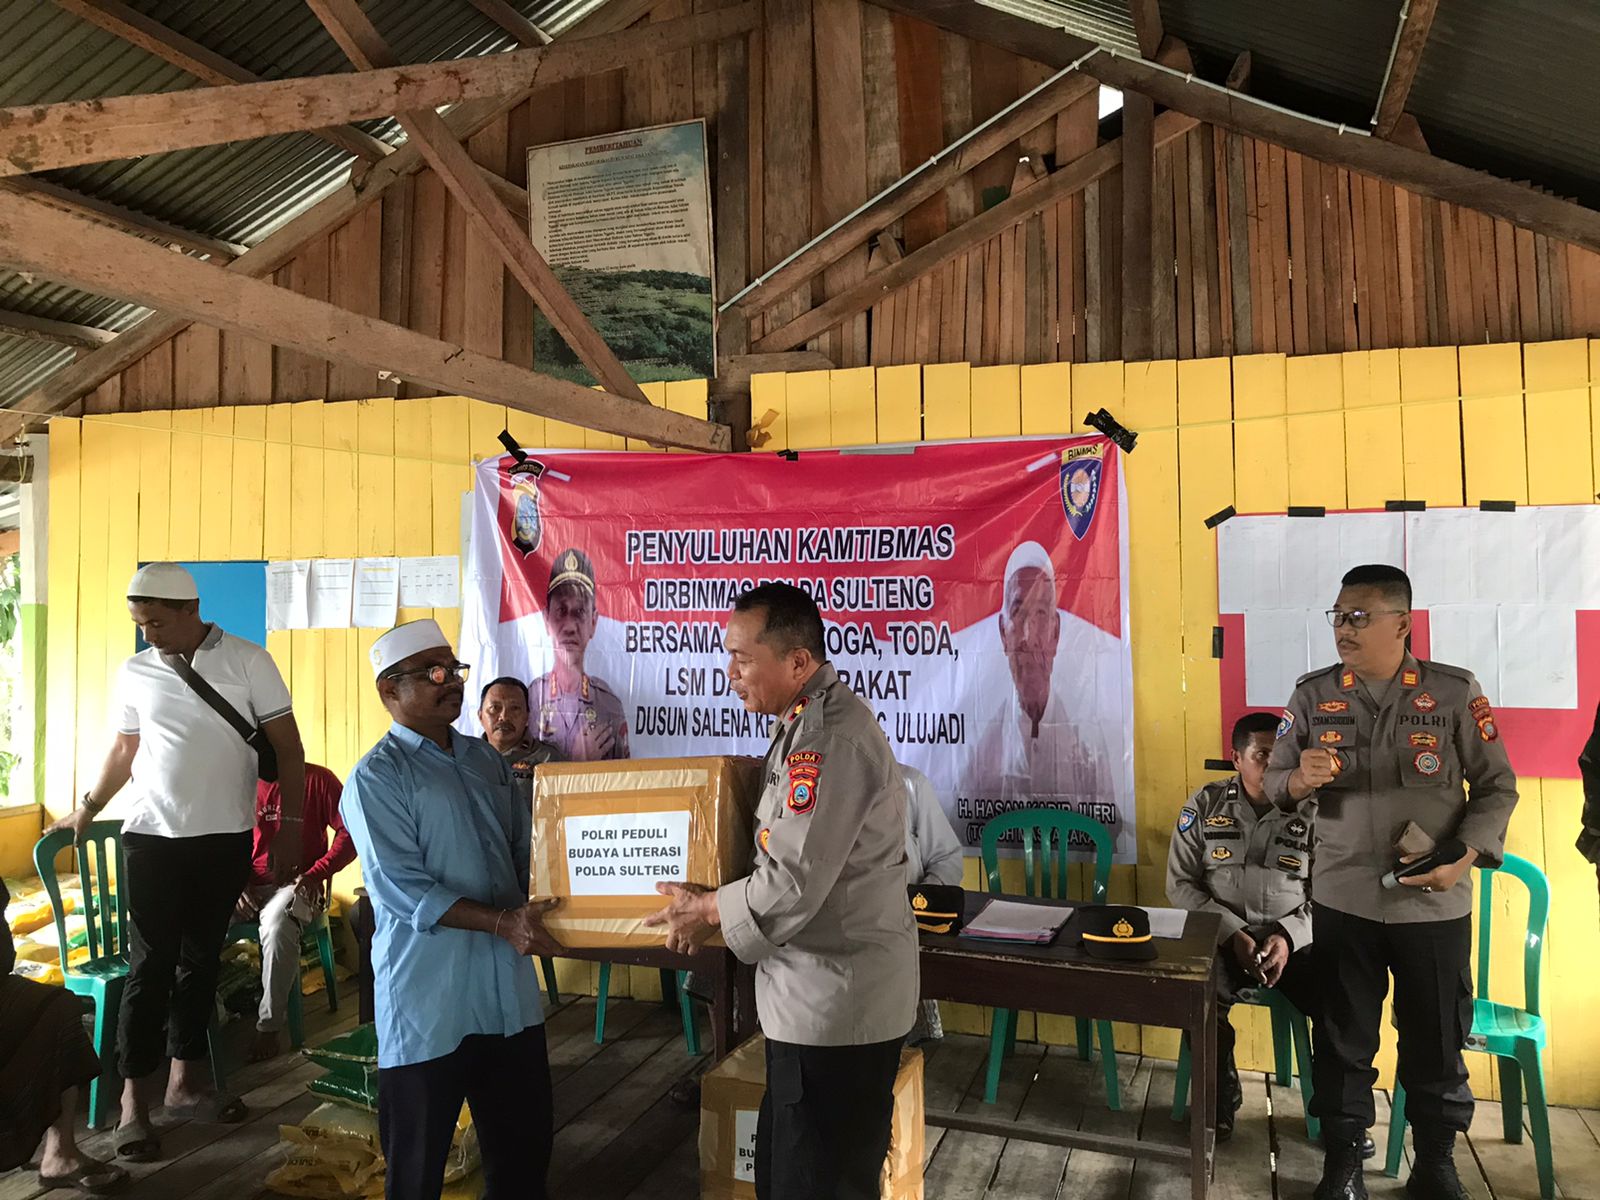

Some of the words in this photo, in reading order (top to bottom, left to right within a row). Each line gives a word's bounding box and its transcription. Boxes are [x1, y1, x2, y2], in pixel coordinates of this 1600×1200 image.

[627, 530, 790, 563] PENYULUHAN
[799, 525, 954, 561] KAMTIBMAS
[832, 577, 933, 609] SULTENG
[625, 625, 725, 653] BERSAMA
[823, 625, 882, 660] OGA,
[888, 625, 959, 661] TODA,
[665, 667, 705, 697] LSM
[712, 667, 734, 697] DA
[837, 670, 911, 700] RAKAT
[635, 706, 688, 736] DUSUN
[692, 707, 752, 738] SALENA
[896, 711, 966, 744] ULUJADI
[1400, 714, 1446, 727] POLRI
[790, 753, 816, 763] POLDA
[958, 798, 973, 819] H.
[581, 829, 618, 840] POLRI
[621, 828, 668, 840] PEDULI
[568, 847, 619, 859] BUDAYA
[623, 846, 682, 858] LITERASI
[575, 865, 616, 877] POLDA
[619, 864, 681, 876] SULTENG
